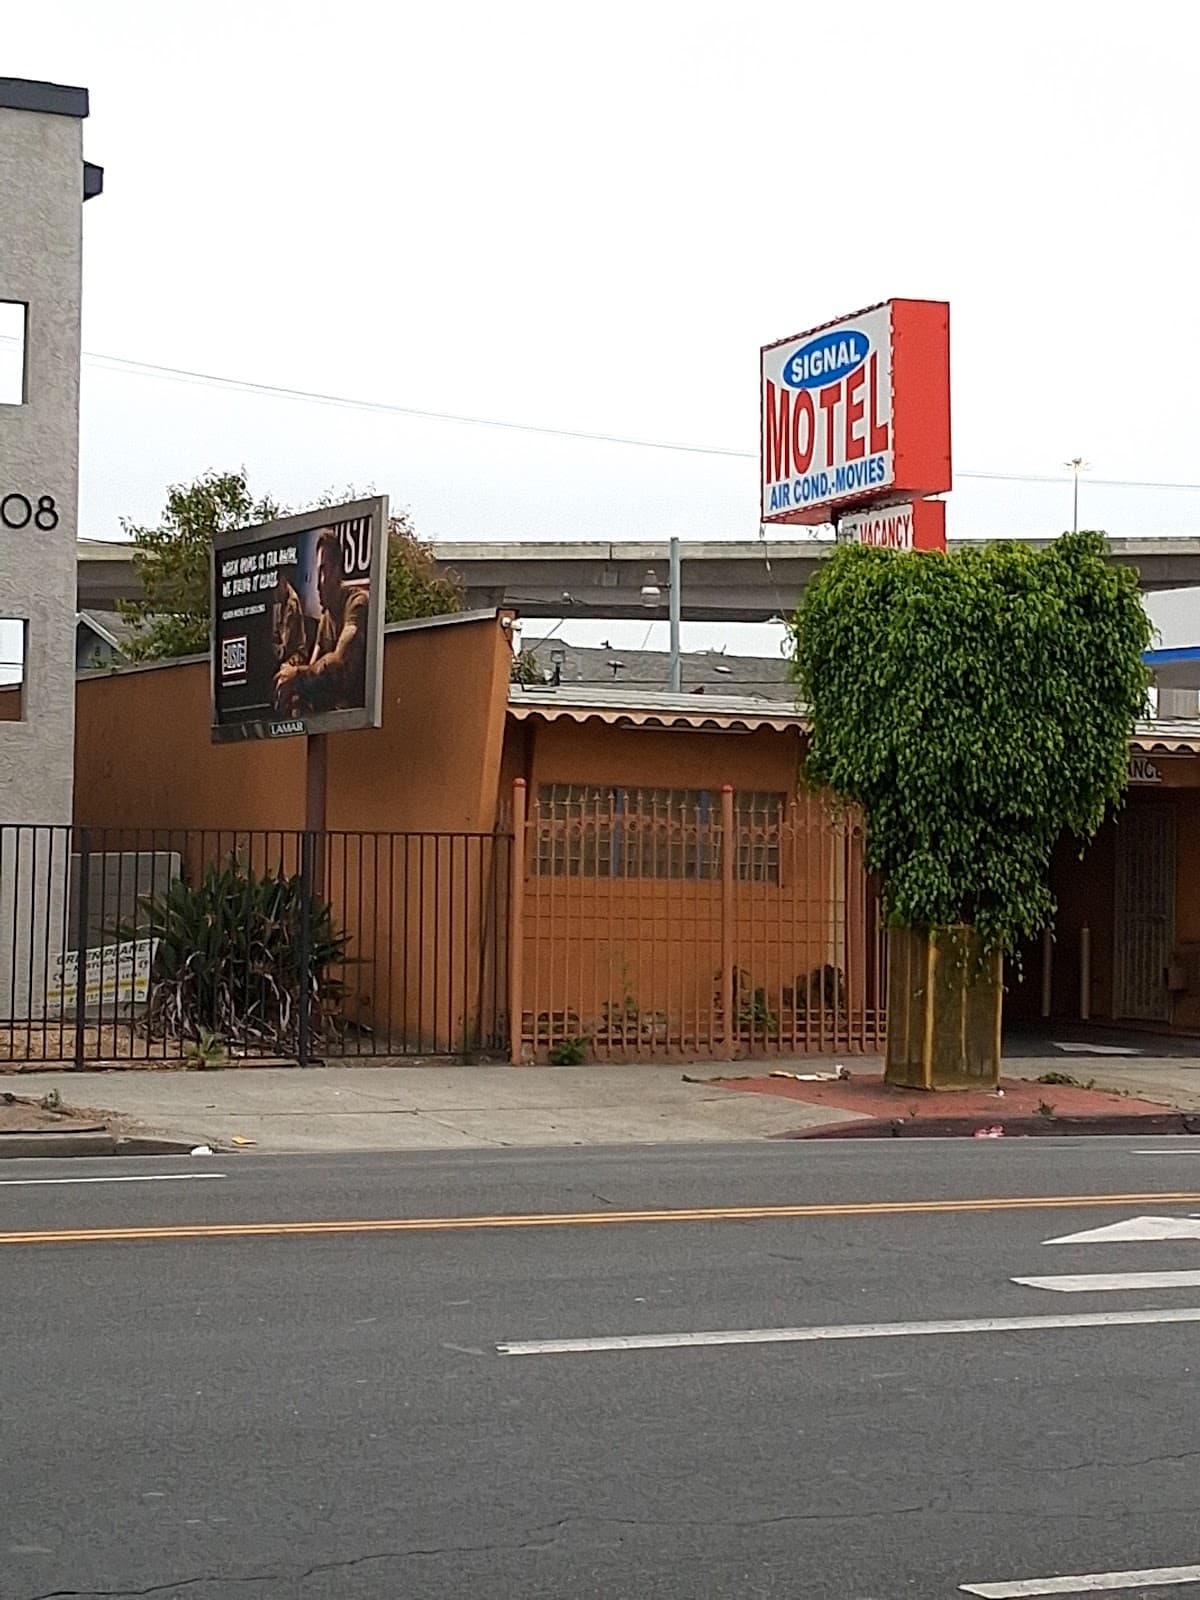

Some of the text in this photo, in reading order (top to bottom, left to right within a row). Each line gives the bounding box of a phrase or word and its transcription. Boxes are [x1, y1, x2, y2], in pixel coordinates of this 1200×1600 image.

[791, 337, 861, 383] SIGNAL
[766, 351, 889, 484] MOTEL
[770, 482, 790, 510] AIR
[860, 514, 910, 548] VACANCY
[271, 721, 303, 735] LAMAR
